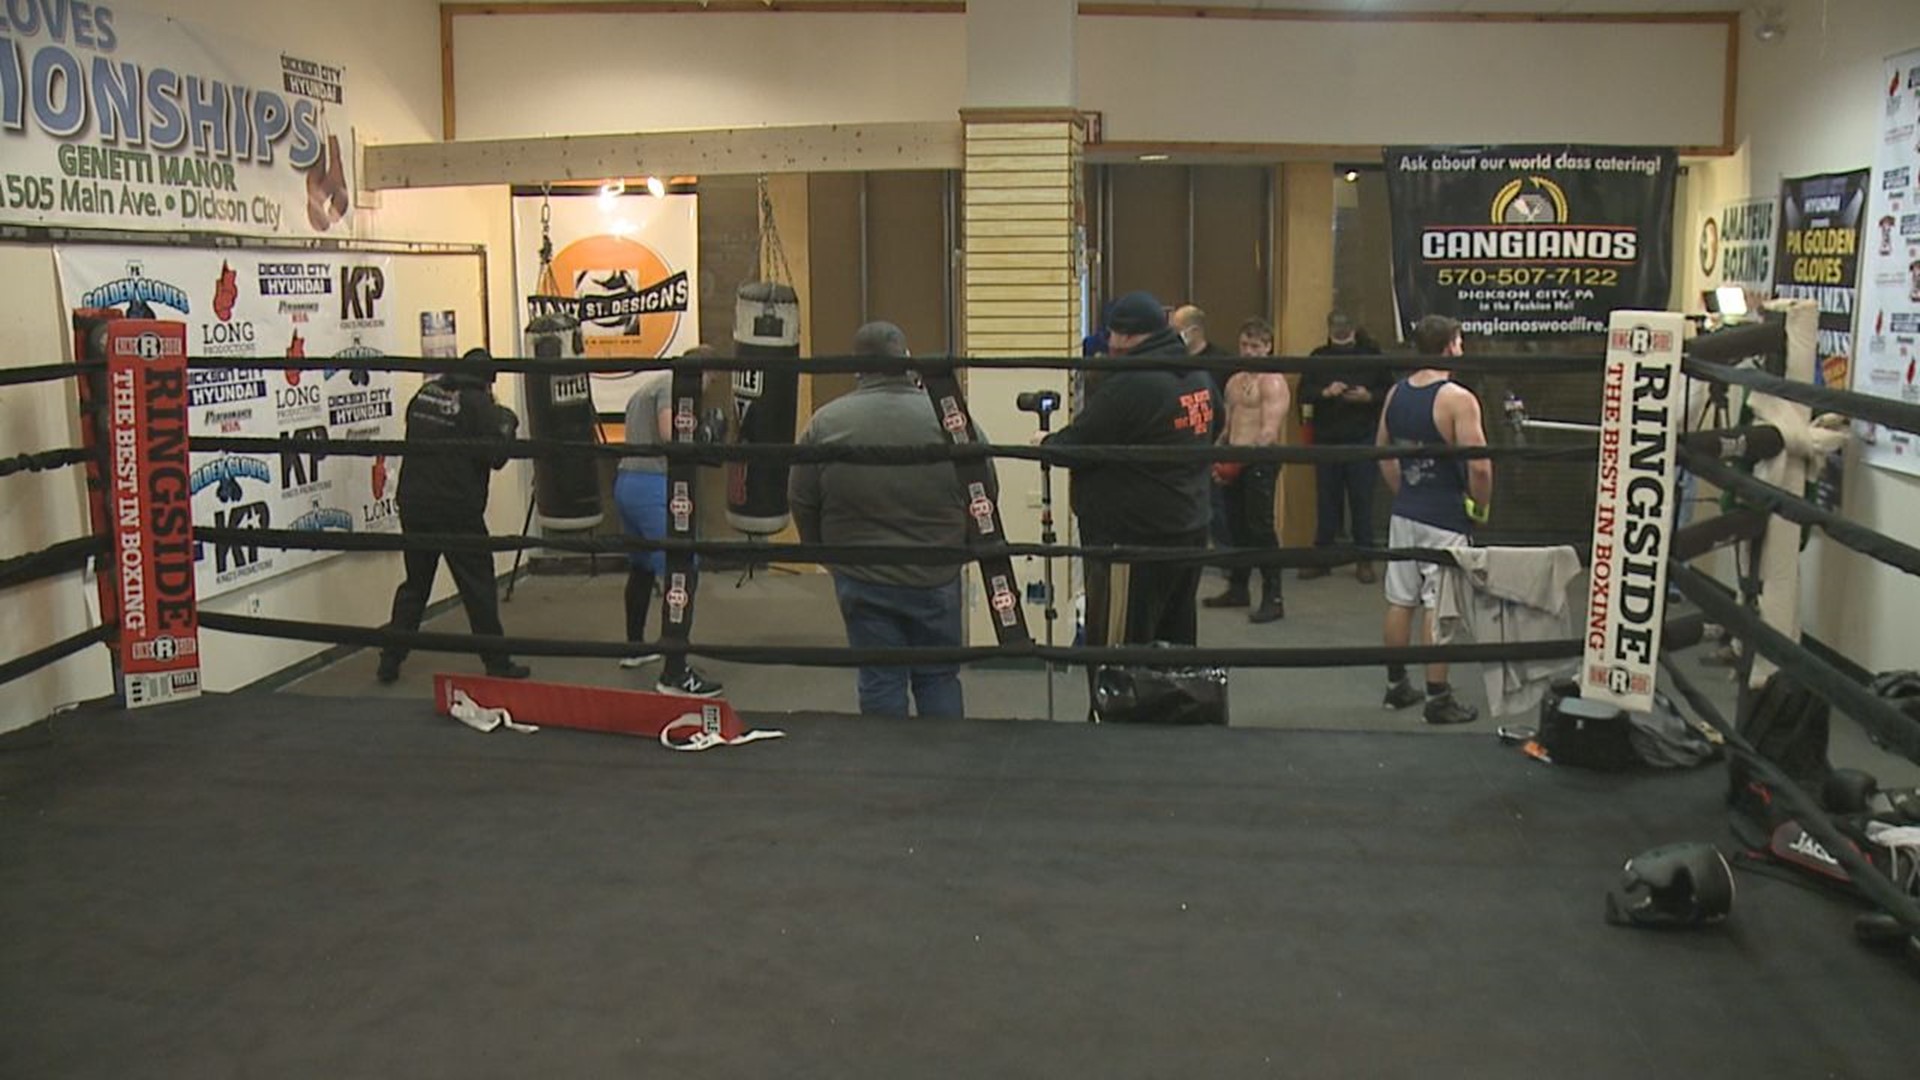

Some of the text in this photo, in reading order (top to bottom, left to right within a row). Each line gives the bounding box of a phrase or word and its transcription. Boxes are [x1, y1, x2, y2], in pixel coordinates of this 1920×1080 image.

[0, 0, 117, 51] OVES
[288, 76, 336, 101] HYUNDAI
[58, 144, 238, 192] GENETTI MANOR
[1400, 152, 1661, 175] Ask about our world class catering!
[61, 179, 114, 214] Main
[119, 183, 161, 217] Ave.
[181, 189, 247, 223] Dickson
[252, 196, 281, 231] City
[1422, 231, 1636, 259] CANGIANOS
[1803, 228, 1856, 255] GOLDEN
[259, 264, 331, 276] DICKSON CITY
[1438, 268, 1618, 286] 570-507-7122
[1723, 245, 1769, 282] BOXING
[1794, 258, 1842, 283] GLOVES
[83, 279, 135, 309] GOLDEN
[268, 277, 325, 294] HYUNDAI
[341, 266, 384, 320] KP
[586, 302, 608, 317] ST.
[612, 279, 688, 314] DESIGNS
[1458, 290, 1530, 300] DICKSON
[1575, 290, 1594, 299] PA
[202, 322, 255, 345] LONG
[187, 368, 234, 385] ICKSON
[556, 375, 587, 397] TITLE
[114, 369, 136, 425] THE
[192, 381, 259, 405] HYUNDAI
[275, 385, 321, 410] LONG
[369, 389, 392, 403] CITY
[1604, 363, 1624, 422] THE
[335, 403, 387, 425] HYUNDAI
[116, 427, 139, 494] BEST
[1600, 428, 1620, 499] BEST
[191, 459, 225, 496] OLDEN
[119, 496, 141, 527] IN
[145, 366, 194, 631] RINGSIDE
[1615, 362, 1672, 665] RINGSIDE
[1597, 504, 1615, 537] IN
[121, 530, 146, 631] BOXING
[1589, 544, 1612, 651] BOXING
